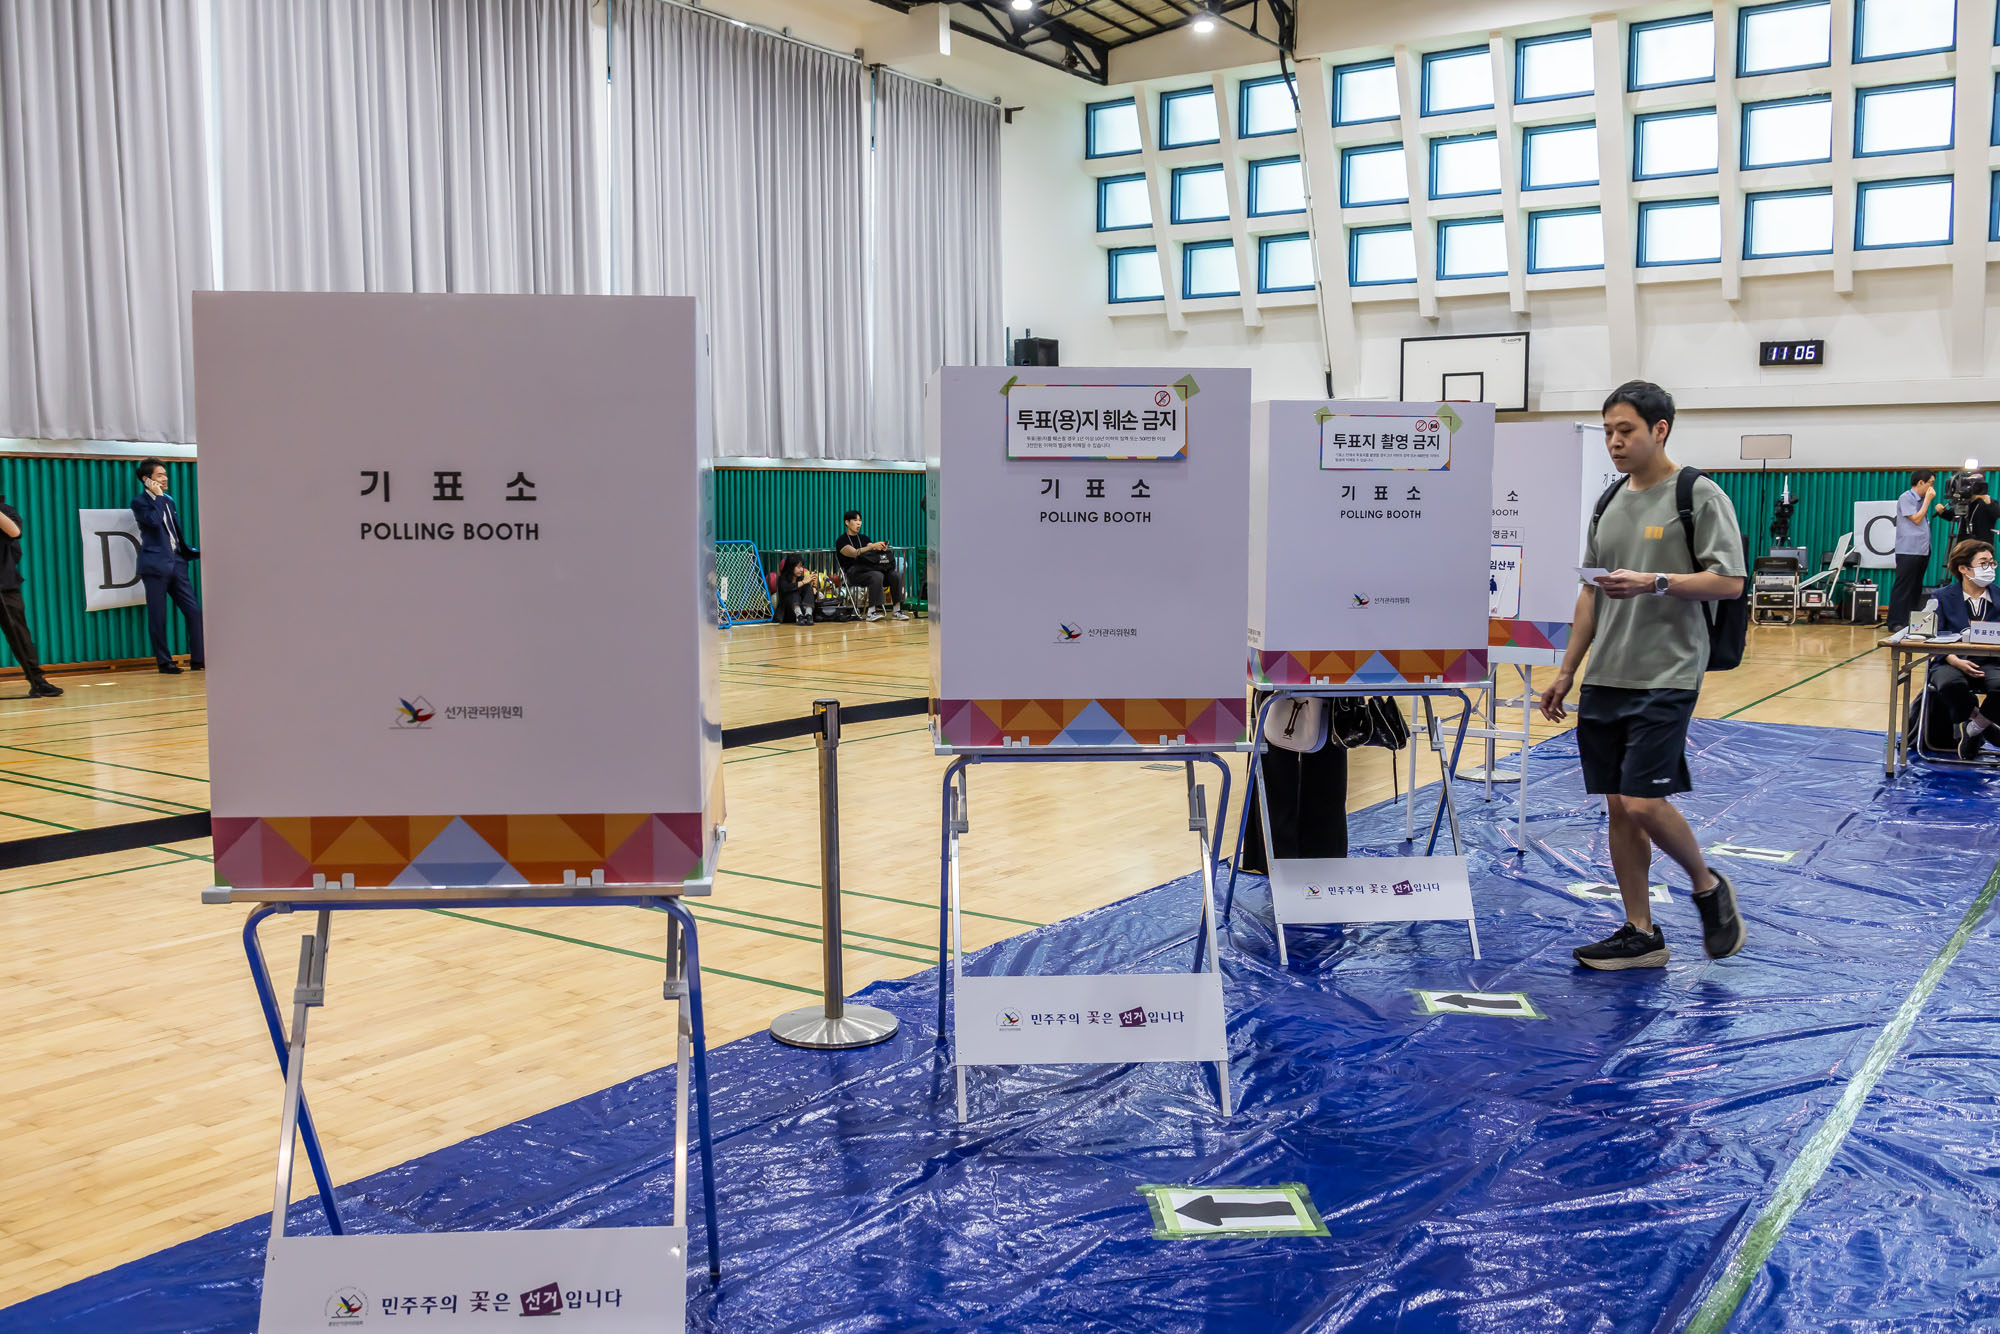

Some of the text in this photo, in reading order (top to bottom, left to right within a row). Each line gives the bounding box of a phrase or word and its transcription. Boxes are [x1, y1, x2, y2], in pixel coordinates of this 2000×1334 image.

[1794, 344, 1817, 360] 06
[1017, 410, 1176, 433] 투표(용)지 훼손 금지
[1333, 433, 1440, 450] 투표지 촬영 금지
[1507, 490, 1519, 502] 소
[1040, 511, 1152, 523] POLLING BOOTH
[1341, 510, 1421, 519] POLLING BOOTH
[361, 522, 539, 540] POLLING BOOTH
[1864, 515, 1897, 556] C
[94, 531, 142, 590] D
[1374, 597, 1410, 605] 선거관리위원회
[1088, 627, 1137, 638] 선거관리위원회
[444, 705, 523, 720] 선거관리위원회
[1328, 885, 1365, 896] 민주주의
[1369, 883, 1389, 894] 꽃은
[1031, 1013, 1080, 1025] 민주주의
[1087, 1010, 1114, 1025] 꽃은
[382, 1294, 458, 1316] 민주주의
[469, 1290, 511, 1313] 꽃은
